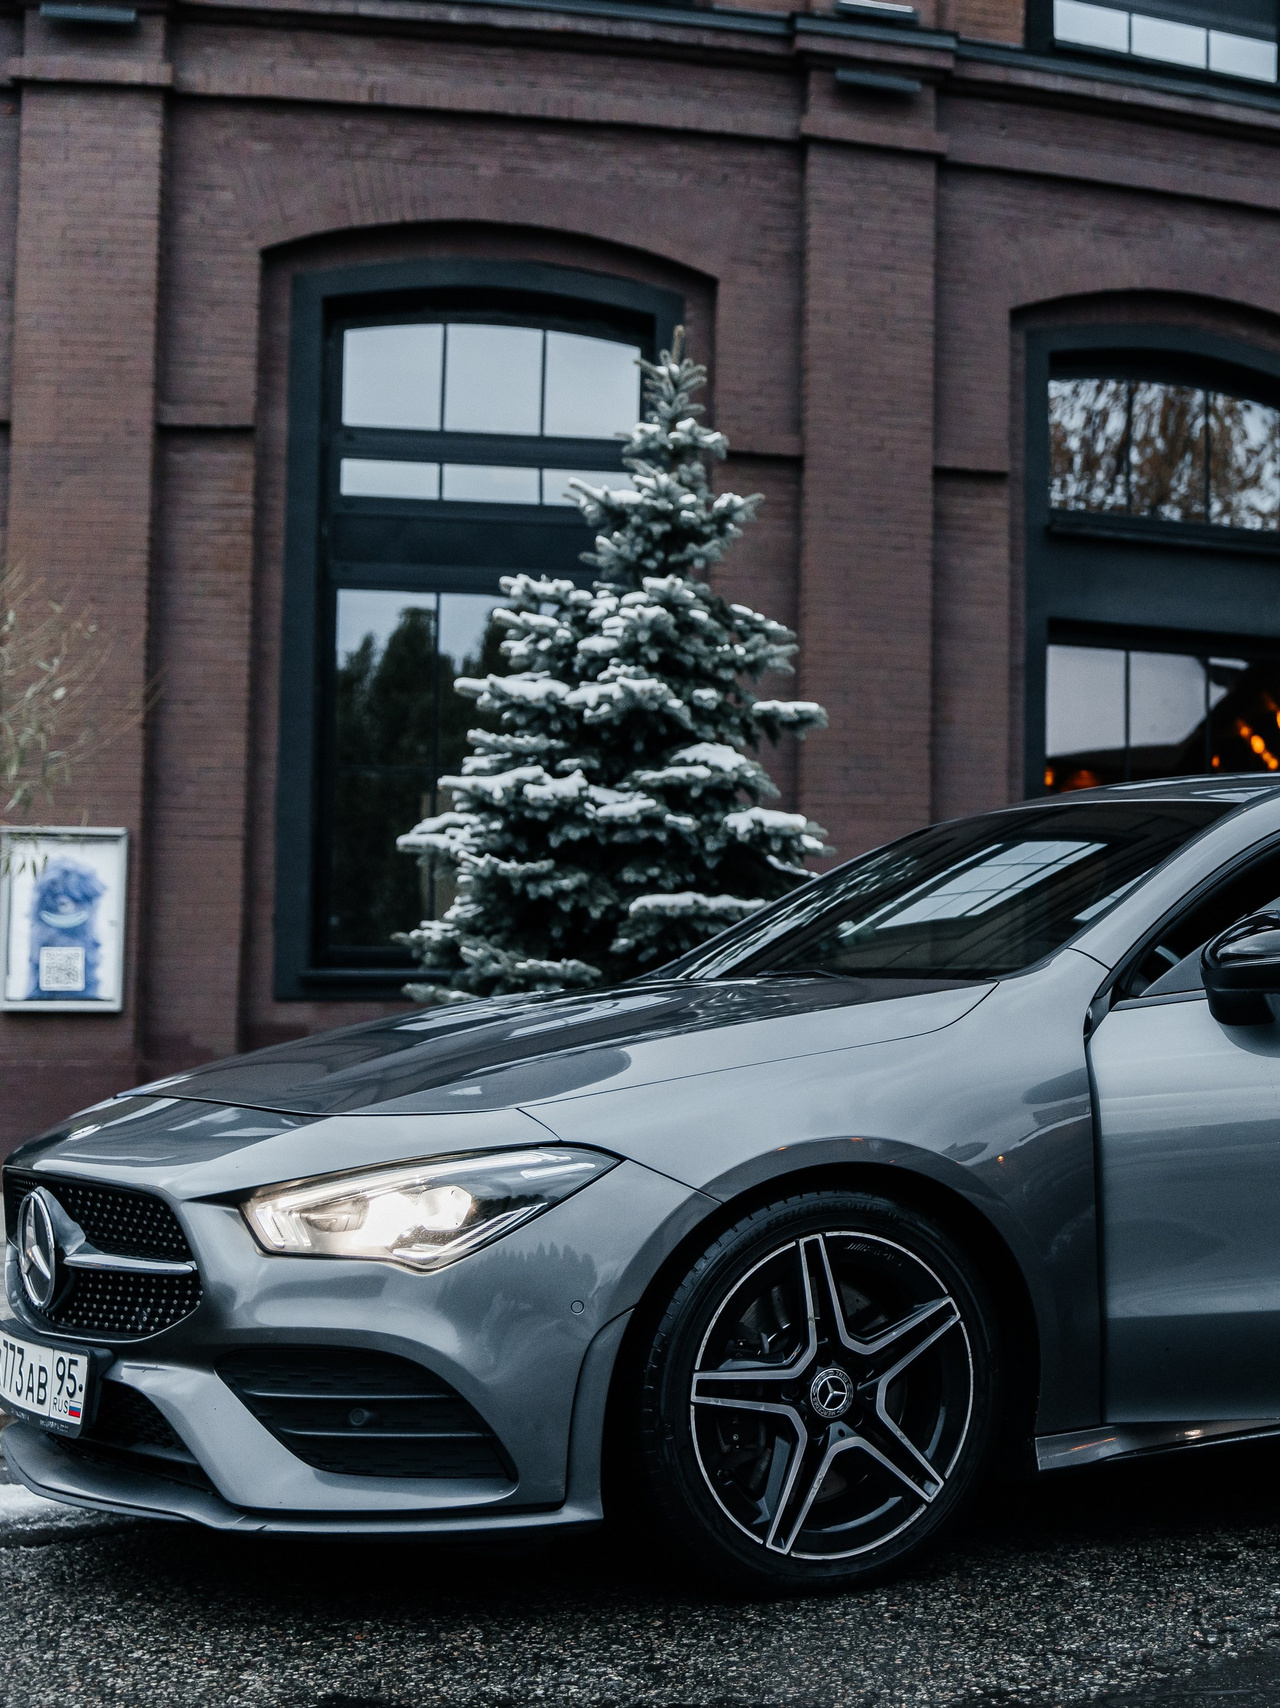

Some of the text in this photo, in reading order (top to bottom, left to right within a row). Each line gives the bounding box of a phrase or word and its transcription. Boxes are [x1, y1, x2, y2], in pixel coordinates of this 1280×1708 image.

[0, 1339, 48, 1406] 773AB
[56, 1356, 79, 1399] 95
[52, 1397, 69, 1414] RUS
